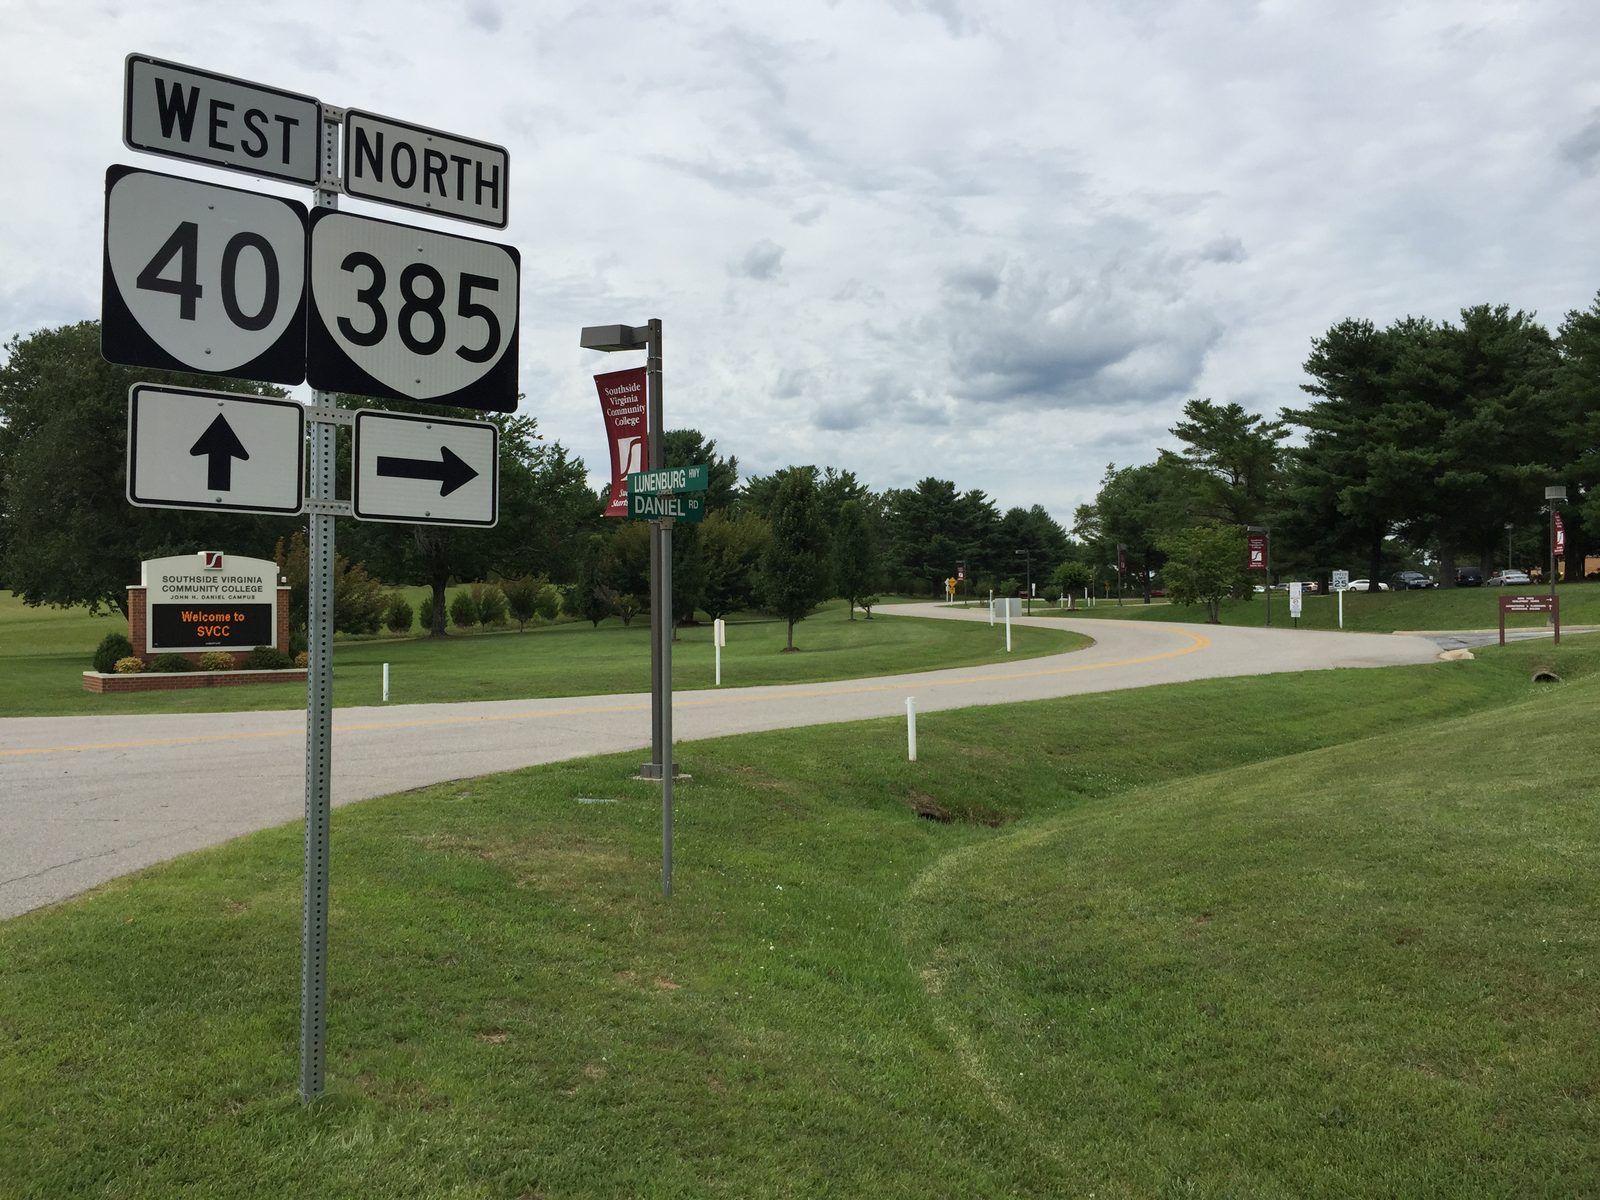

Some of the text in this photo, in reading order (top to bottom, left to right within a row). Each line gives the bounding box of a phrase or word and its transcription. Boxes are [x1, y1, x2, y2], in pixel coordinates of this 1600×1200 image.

[155, 78, 299, 165] WEST
[355, 127, 500, 210] NORTH
[136, 221, 280, 331] 40
[337, 251, 502, 364] 385
[605, 383, 641, 396] Southside
[610, 395, 638, 406] Virginia
[607, 405, 646, 416] Community
[615, 417, 640, 426] College
[635, 469, 699, 493] LUNENBURG HWY
[635, 496, 698, 516] DANIEL RD
[1334, 579, 1347, 588] 25
[181, 611, 245, 622] Welcome to
[197, 626, 230, 637] SVCC
